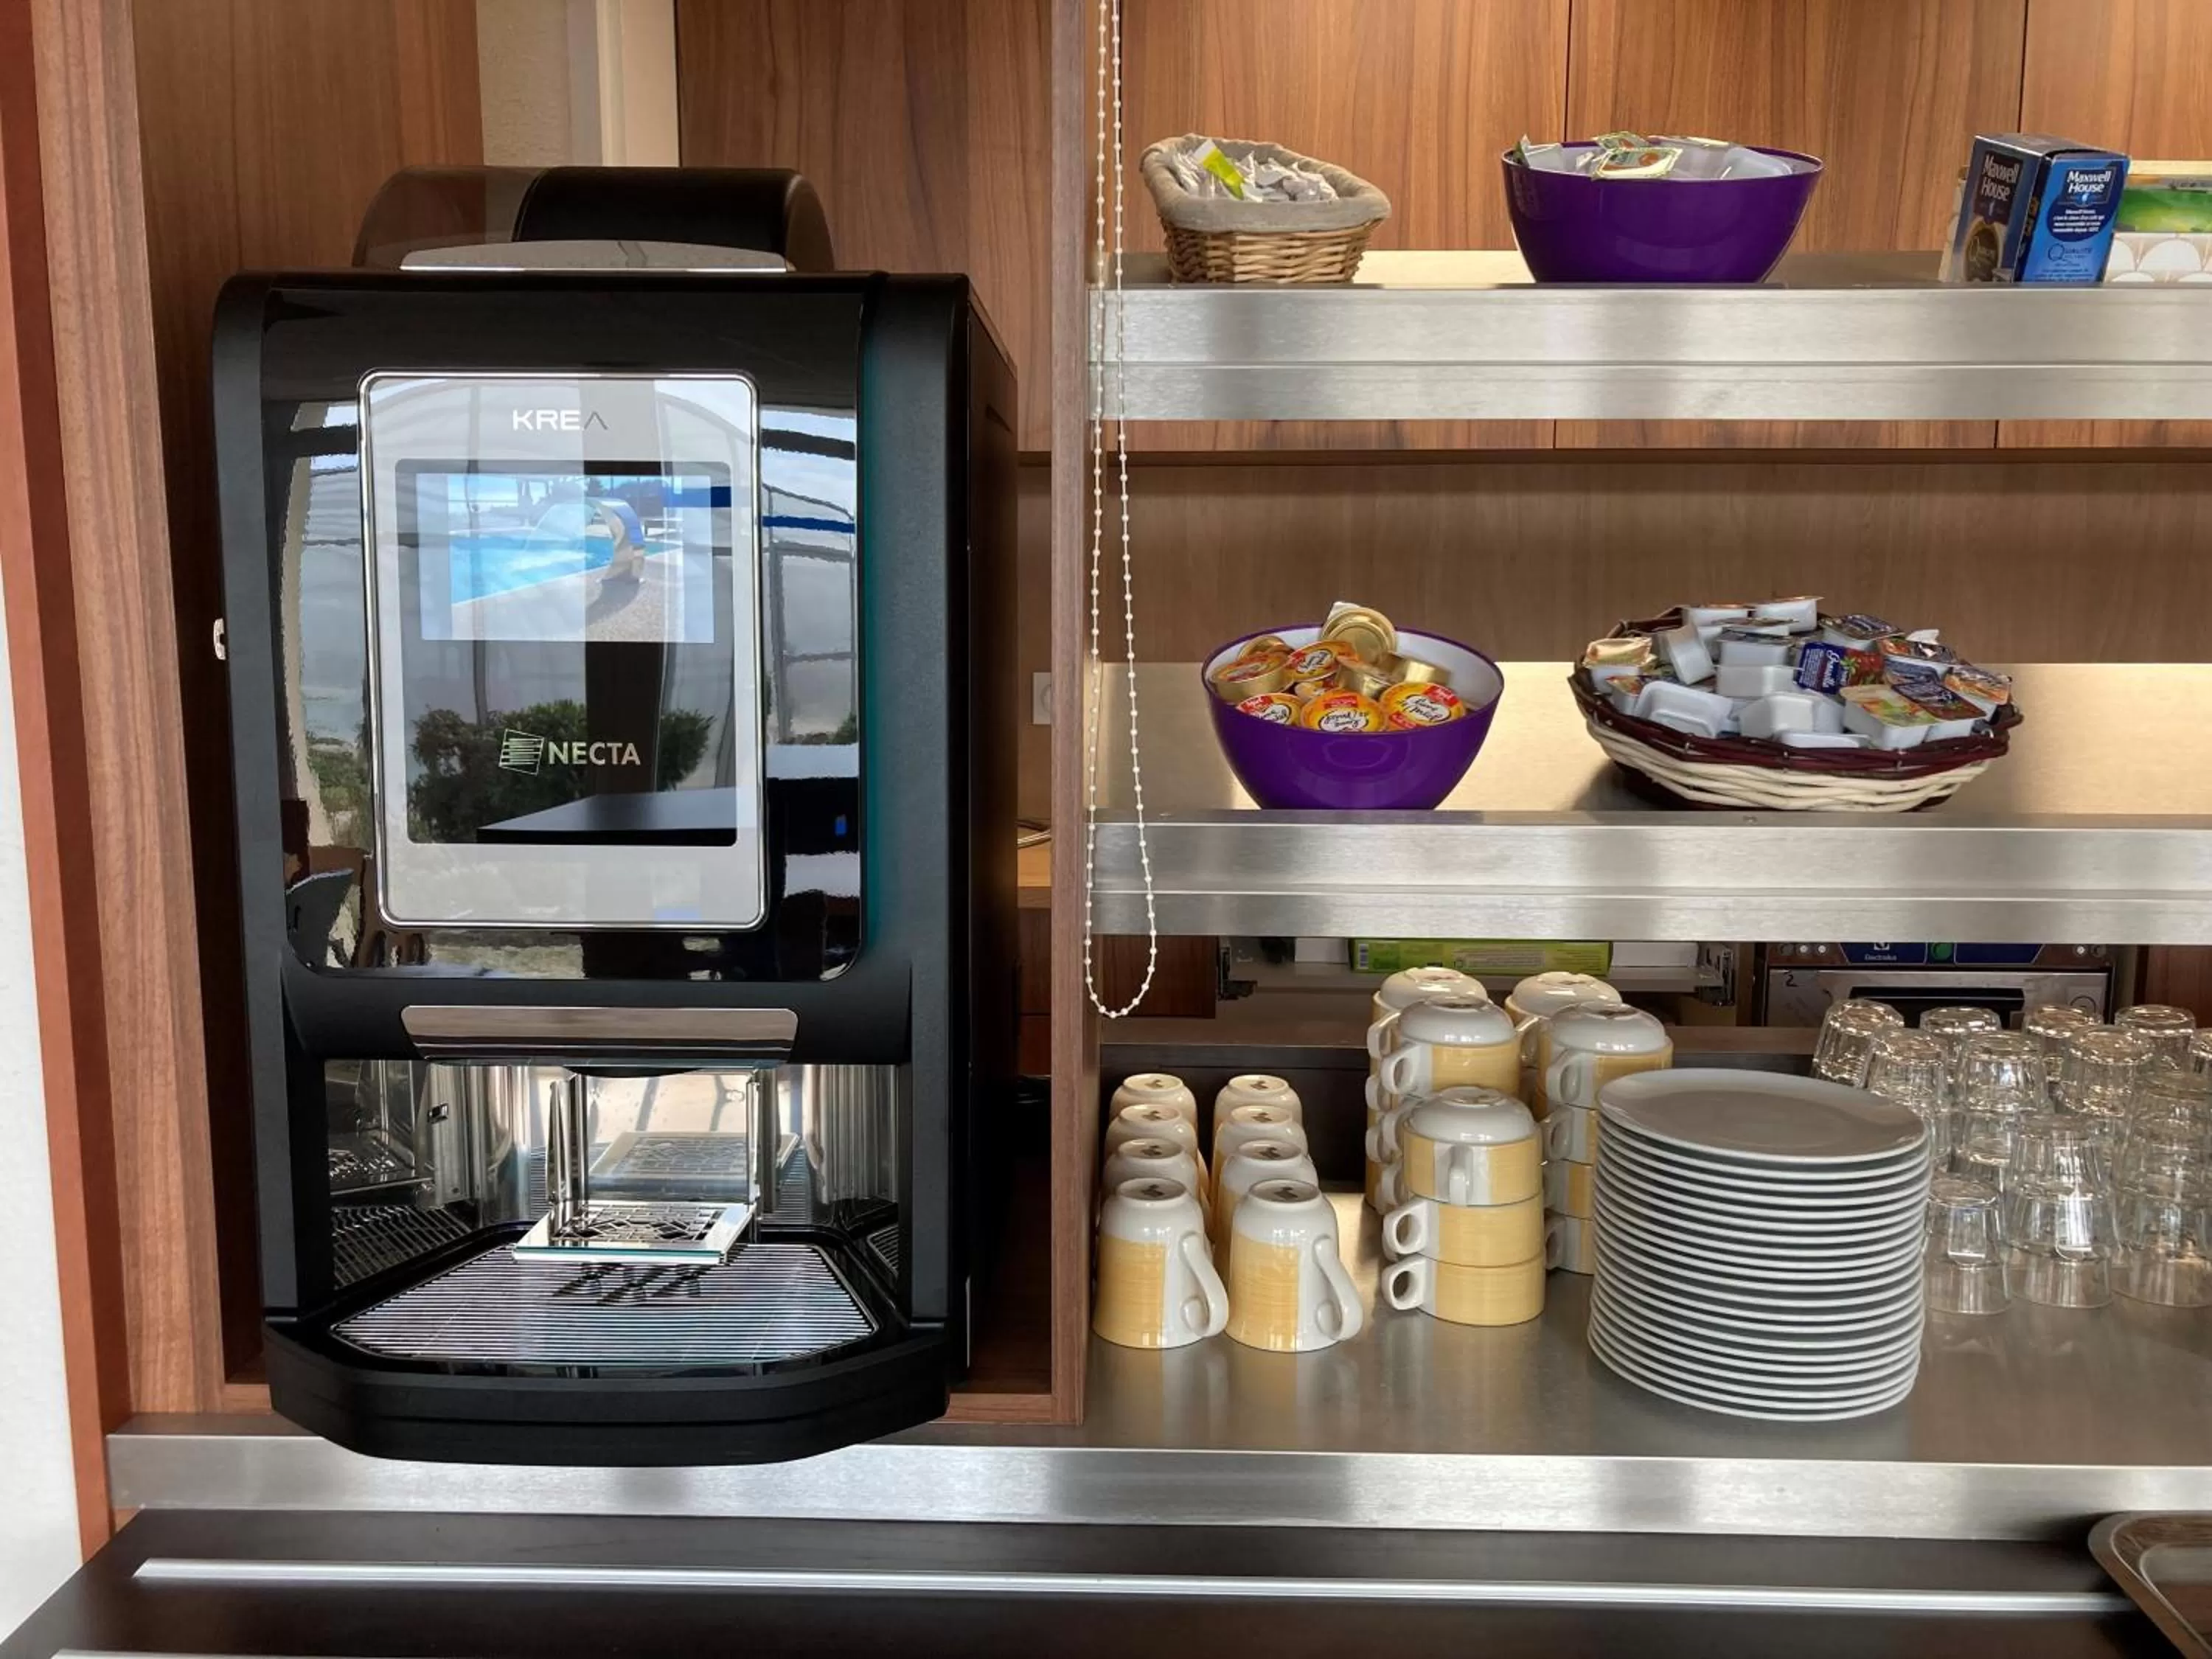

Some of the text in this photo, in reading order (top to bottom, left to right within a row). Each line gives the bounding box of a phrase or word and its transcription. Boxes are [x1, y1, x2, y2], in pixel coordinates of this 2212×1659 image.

[1982, 154, 2020, 184] Maxwell
[2067, 170, 2112, 183] Maxwell
[1980, 176, 2011, 201] House
[2068, 182, 2105, 193] House
[548, 741, 641, 765] NECTA
